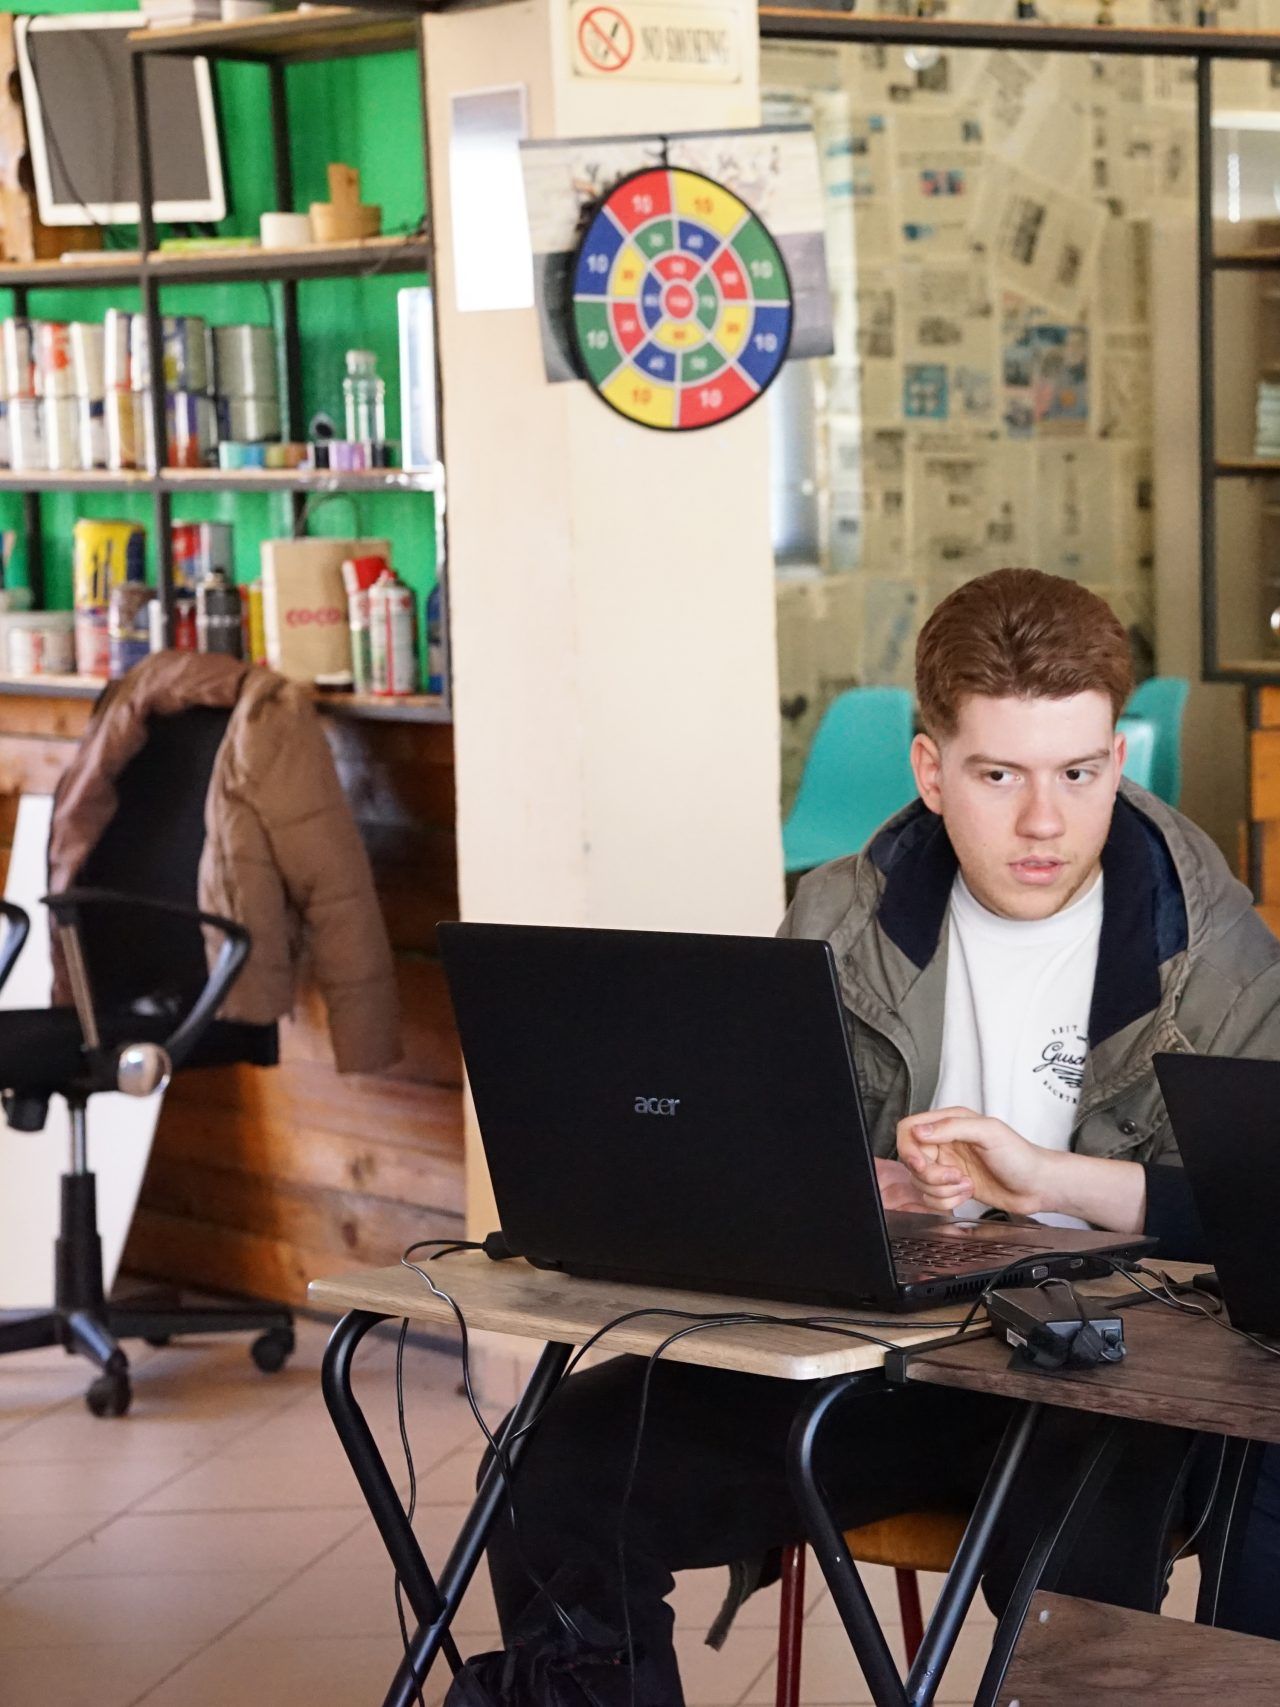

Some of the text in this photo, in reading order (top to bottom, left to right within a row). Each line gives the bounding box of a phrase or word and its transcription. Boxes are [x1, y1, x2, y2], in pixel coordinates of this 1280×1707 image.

[632, 195, 653, 214] 10
[587, 254, 609, 273] 10
[751, 260, 773, 279] 10
[587, 330, 609, 349] 10
[754, 333, 778, 352] 10
[699, 390, 723, 409] 10
[634, 1096, 680, 1116] acer
